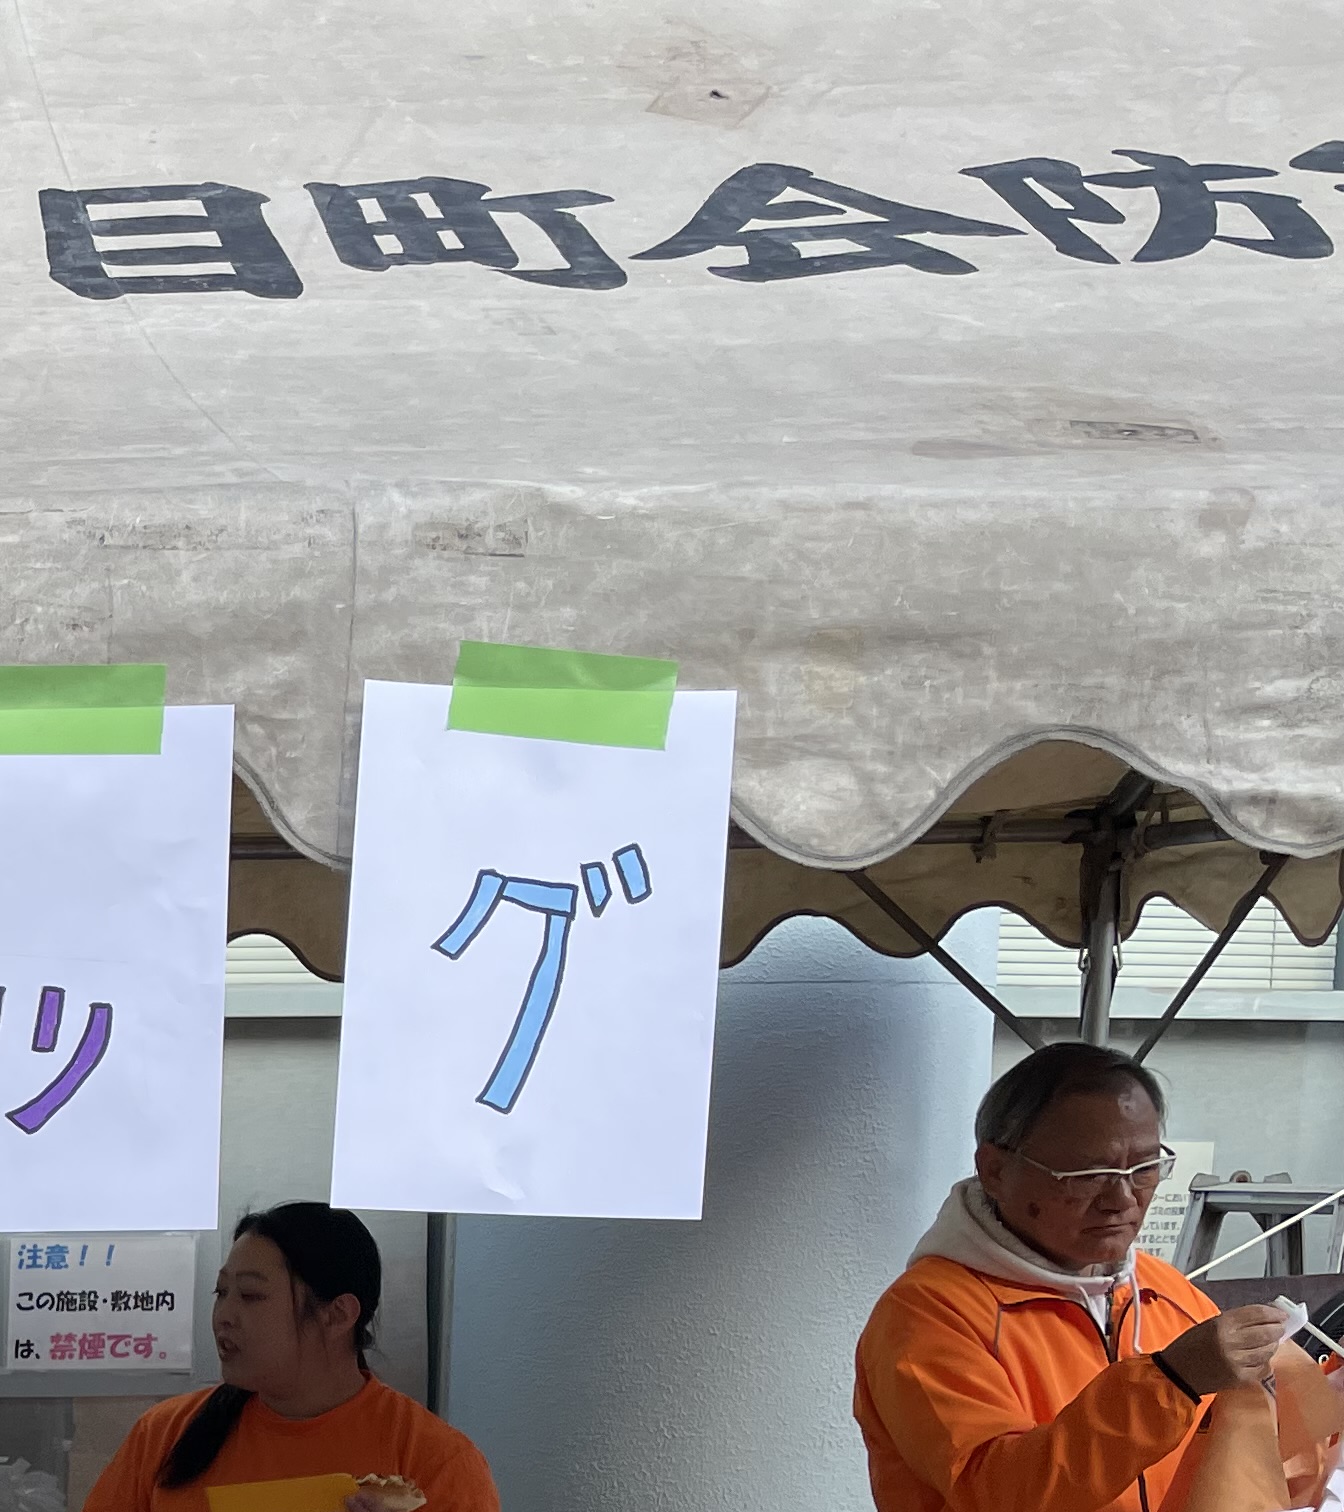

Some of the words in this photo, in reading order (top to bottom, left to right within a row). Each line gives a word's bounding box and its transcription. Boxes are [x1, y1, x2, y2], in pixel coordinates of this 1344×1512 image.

[15, 1290, 175, 1312] この施設・敷地内
